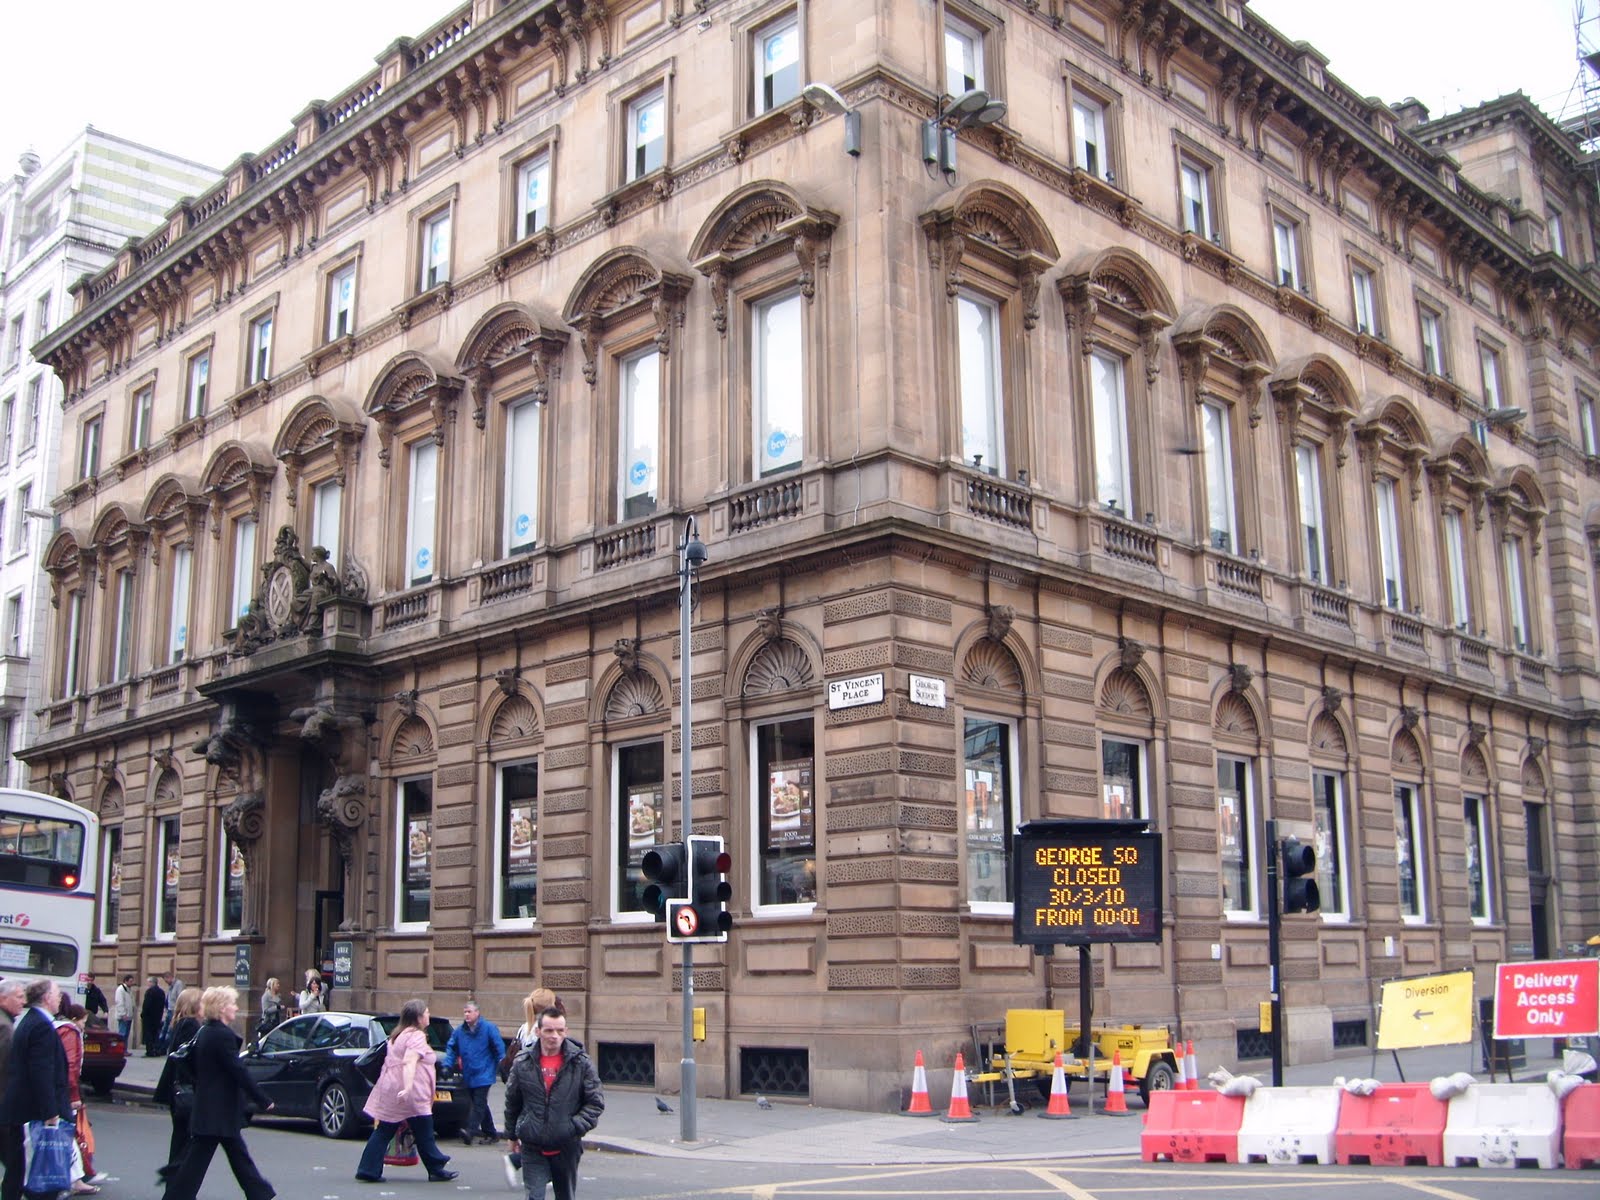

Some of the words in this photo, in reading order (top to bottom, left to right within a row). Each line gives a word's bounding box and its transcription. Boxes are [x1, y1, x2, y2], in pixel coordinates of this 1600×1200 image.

[831, 684, 842, 693] ST
[844, 677, 881, 690] VINCENT
[842, 689, 869, 700] PLACE
[1035, 847, 1103, 865] GEORGE
[1113, 847, 1138, 865] SQ
[1053, 867, 1120, 885] CLOSED
[1049, 887, 1125, 906] 30/3/10
[1035, 908, 1083, 926] FROM
[1093, 908, 1140, 925] 00:01
[1513, 973, 1579, 990] Delivery
[1405, 984, 1449, 999] Diversion
[1517, 991, 1575, 1007] Access
[1527, 1009, 1565, 1026] Only
